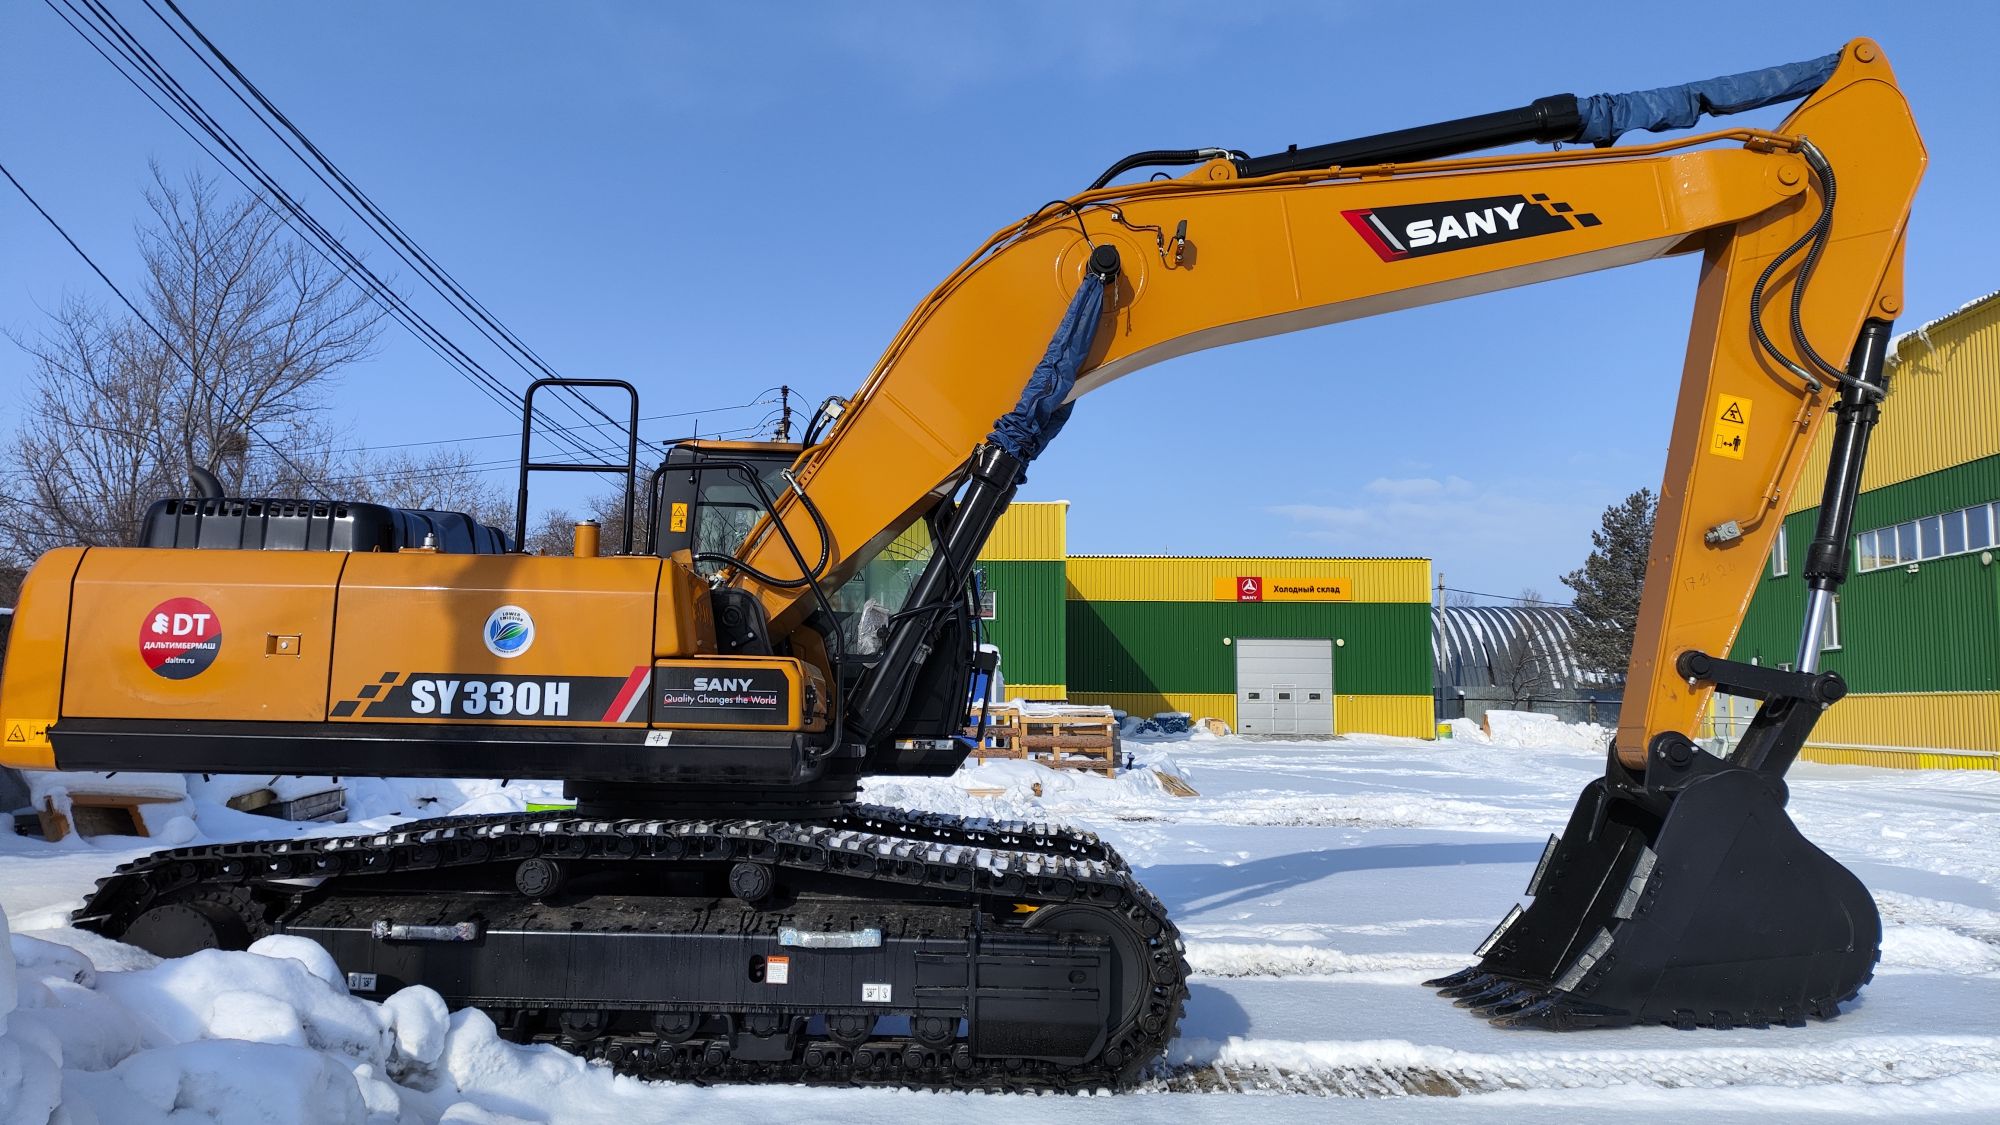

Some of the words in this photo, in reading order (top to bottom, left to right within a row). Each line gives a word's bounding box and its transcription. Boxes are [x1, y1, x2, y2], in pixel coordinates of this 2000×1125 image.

[1405, 202, 1525, 248] SANY
[1273, 585, 1315, 594] Холодный
[172, 613, 211, 636] DT
[144, 642, 216, 650] ДАЛЬТИМБЕРМАШ
[693, 677, 754, 692] SANY
[410, 679, 570, 717] SY330H
[663, 693, 695, 705] Quality
[697, 694, 734, 705] Changes
[735, 694, 749, 704] the
[750, 695, 777, 705] World
